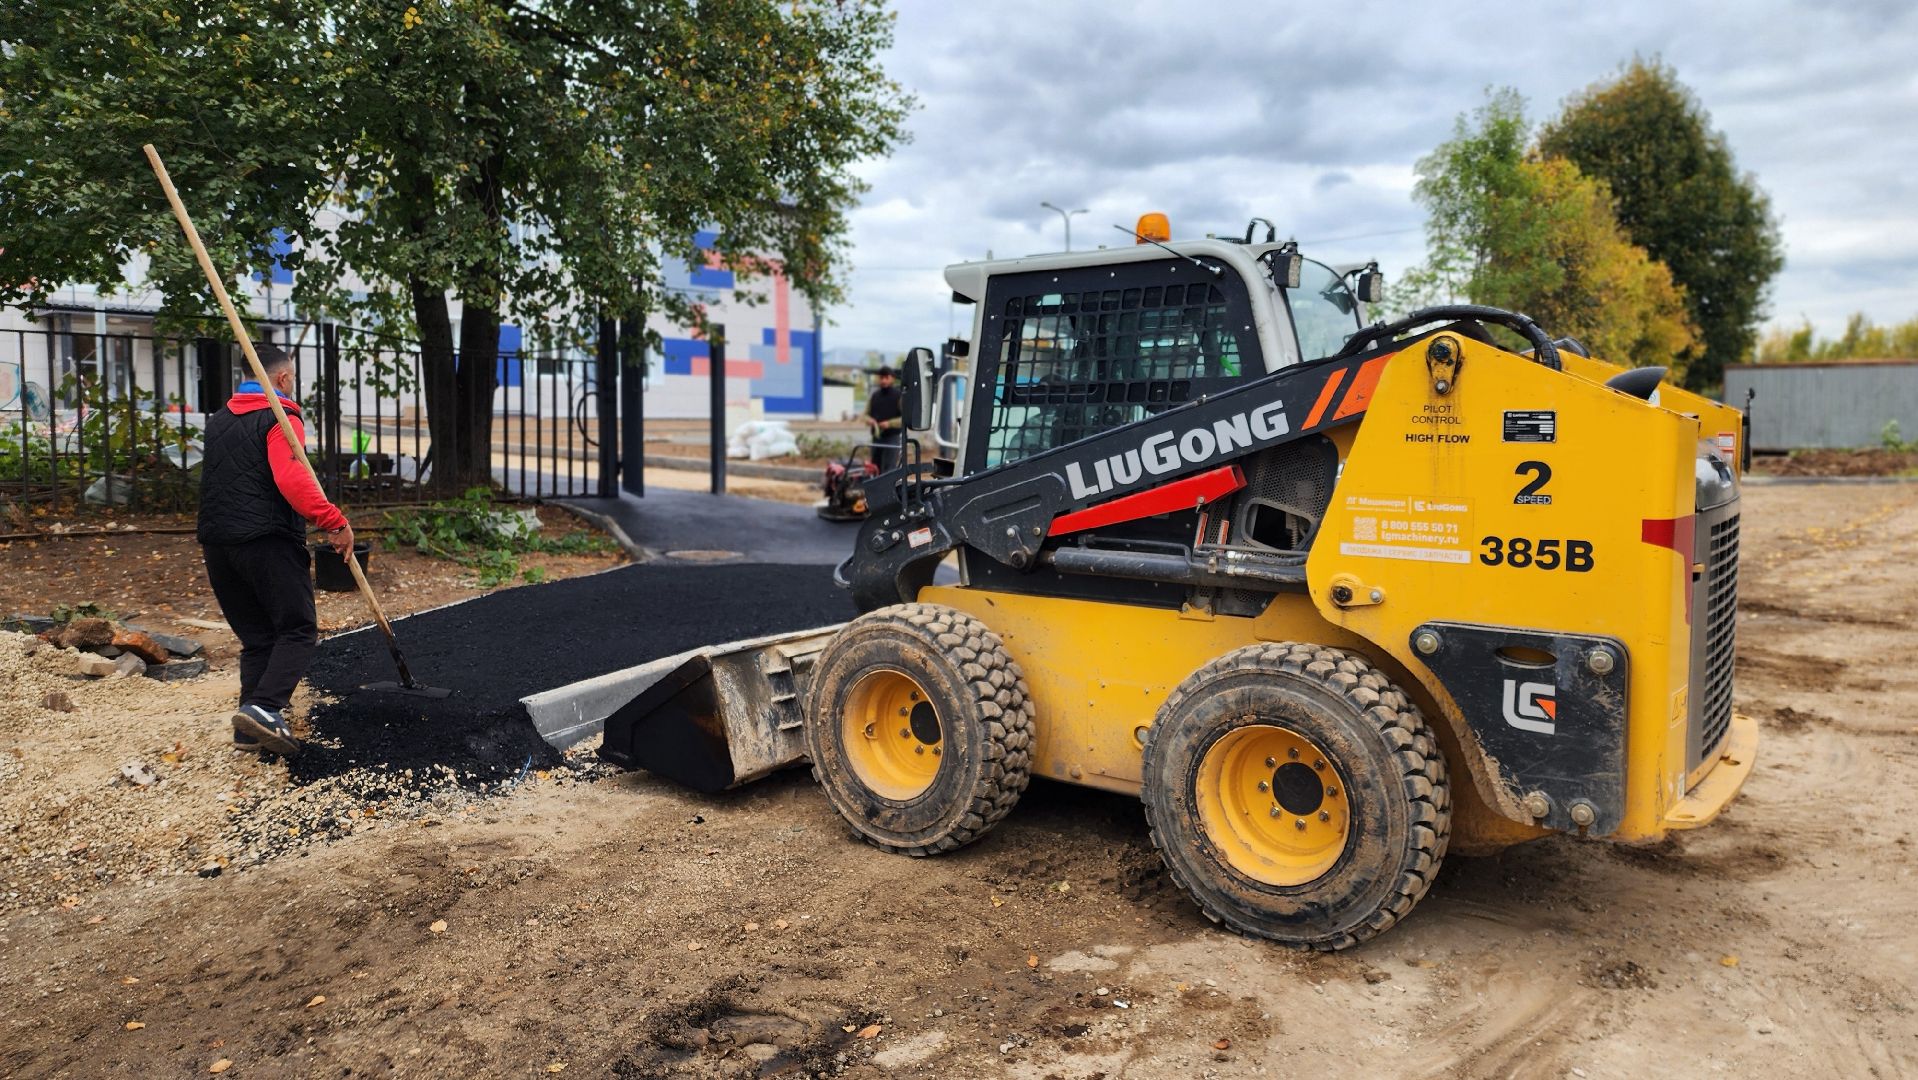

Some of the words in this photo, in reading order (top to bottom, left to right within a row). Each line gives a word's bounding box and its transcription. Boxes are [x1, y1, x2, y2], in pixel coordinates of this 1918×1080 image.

[1423, 405, 1453, 414] PILOT
[1411, 415, 1461, 425] CONTROL
[1405, 433, 1434, 443] HIGH
[1437, 434, 1471, 444] FLOW
[1513, 460, 1553, 504] 2
[1516, 495, 1552, 504] SPEED
[1381, 520, 1388, 529] 8
[1390, 520, 1409, 531] 800
[1410, 521, 1430, 532] 555
[1431, 522, 1444, 533] 50
[1445, 523, 1459, 534] 71
[1381, 530, 1460, 545] lgmachinery.ru
[1479, 535, 1595, 573] 385B
